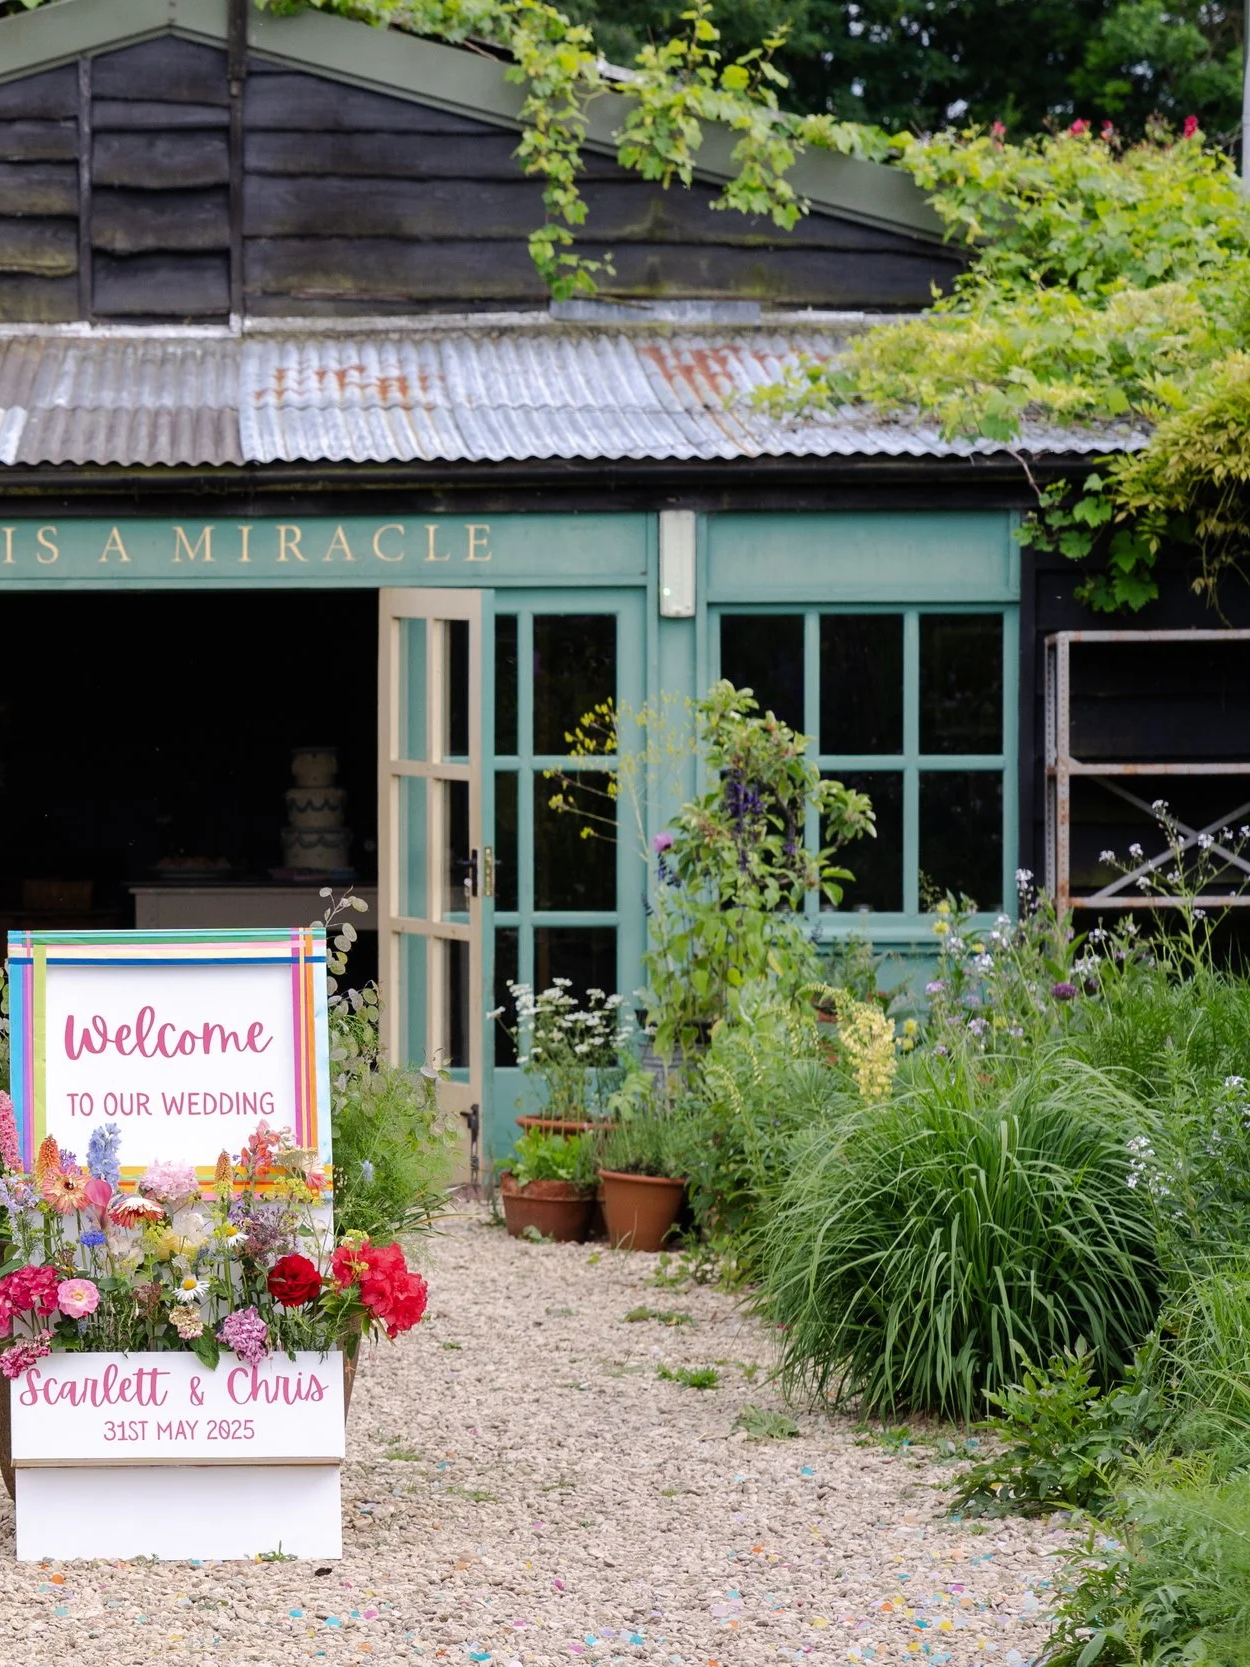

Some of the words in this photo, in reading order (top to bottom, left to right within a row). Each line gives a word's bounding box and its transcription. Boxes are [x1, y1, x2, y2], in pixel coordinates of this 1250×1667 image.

[2, 525, 60, 564] IS
[97, 525, 132, 563] A
[170, 523, 495, 563] MIRACLE
[64, 1005, 273, 1061] Welcome
[66, 1092, 94, 1117] TO
[103, 1092, 152, 1117] OUR
[161, 1091, 276, 1116] WEDDING
[18, 1363, 171, 1408] Scarlett
[188, 1374, 205, 1407] &
[226, 1364, 329, 1406] Chris
[103, 1420, 149, 1441] 31ST
[157, 1420, 199, 1441] MAY
[206, 1419, 255, 1441] 2025
